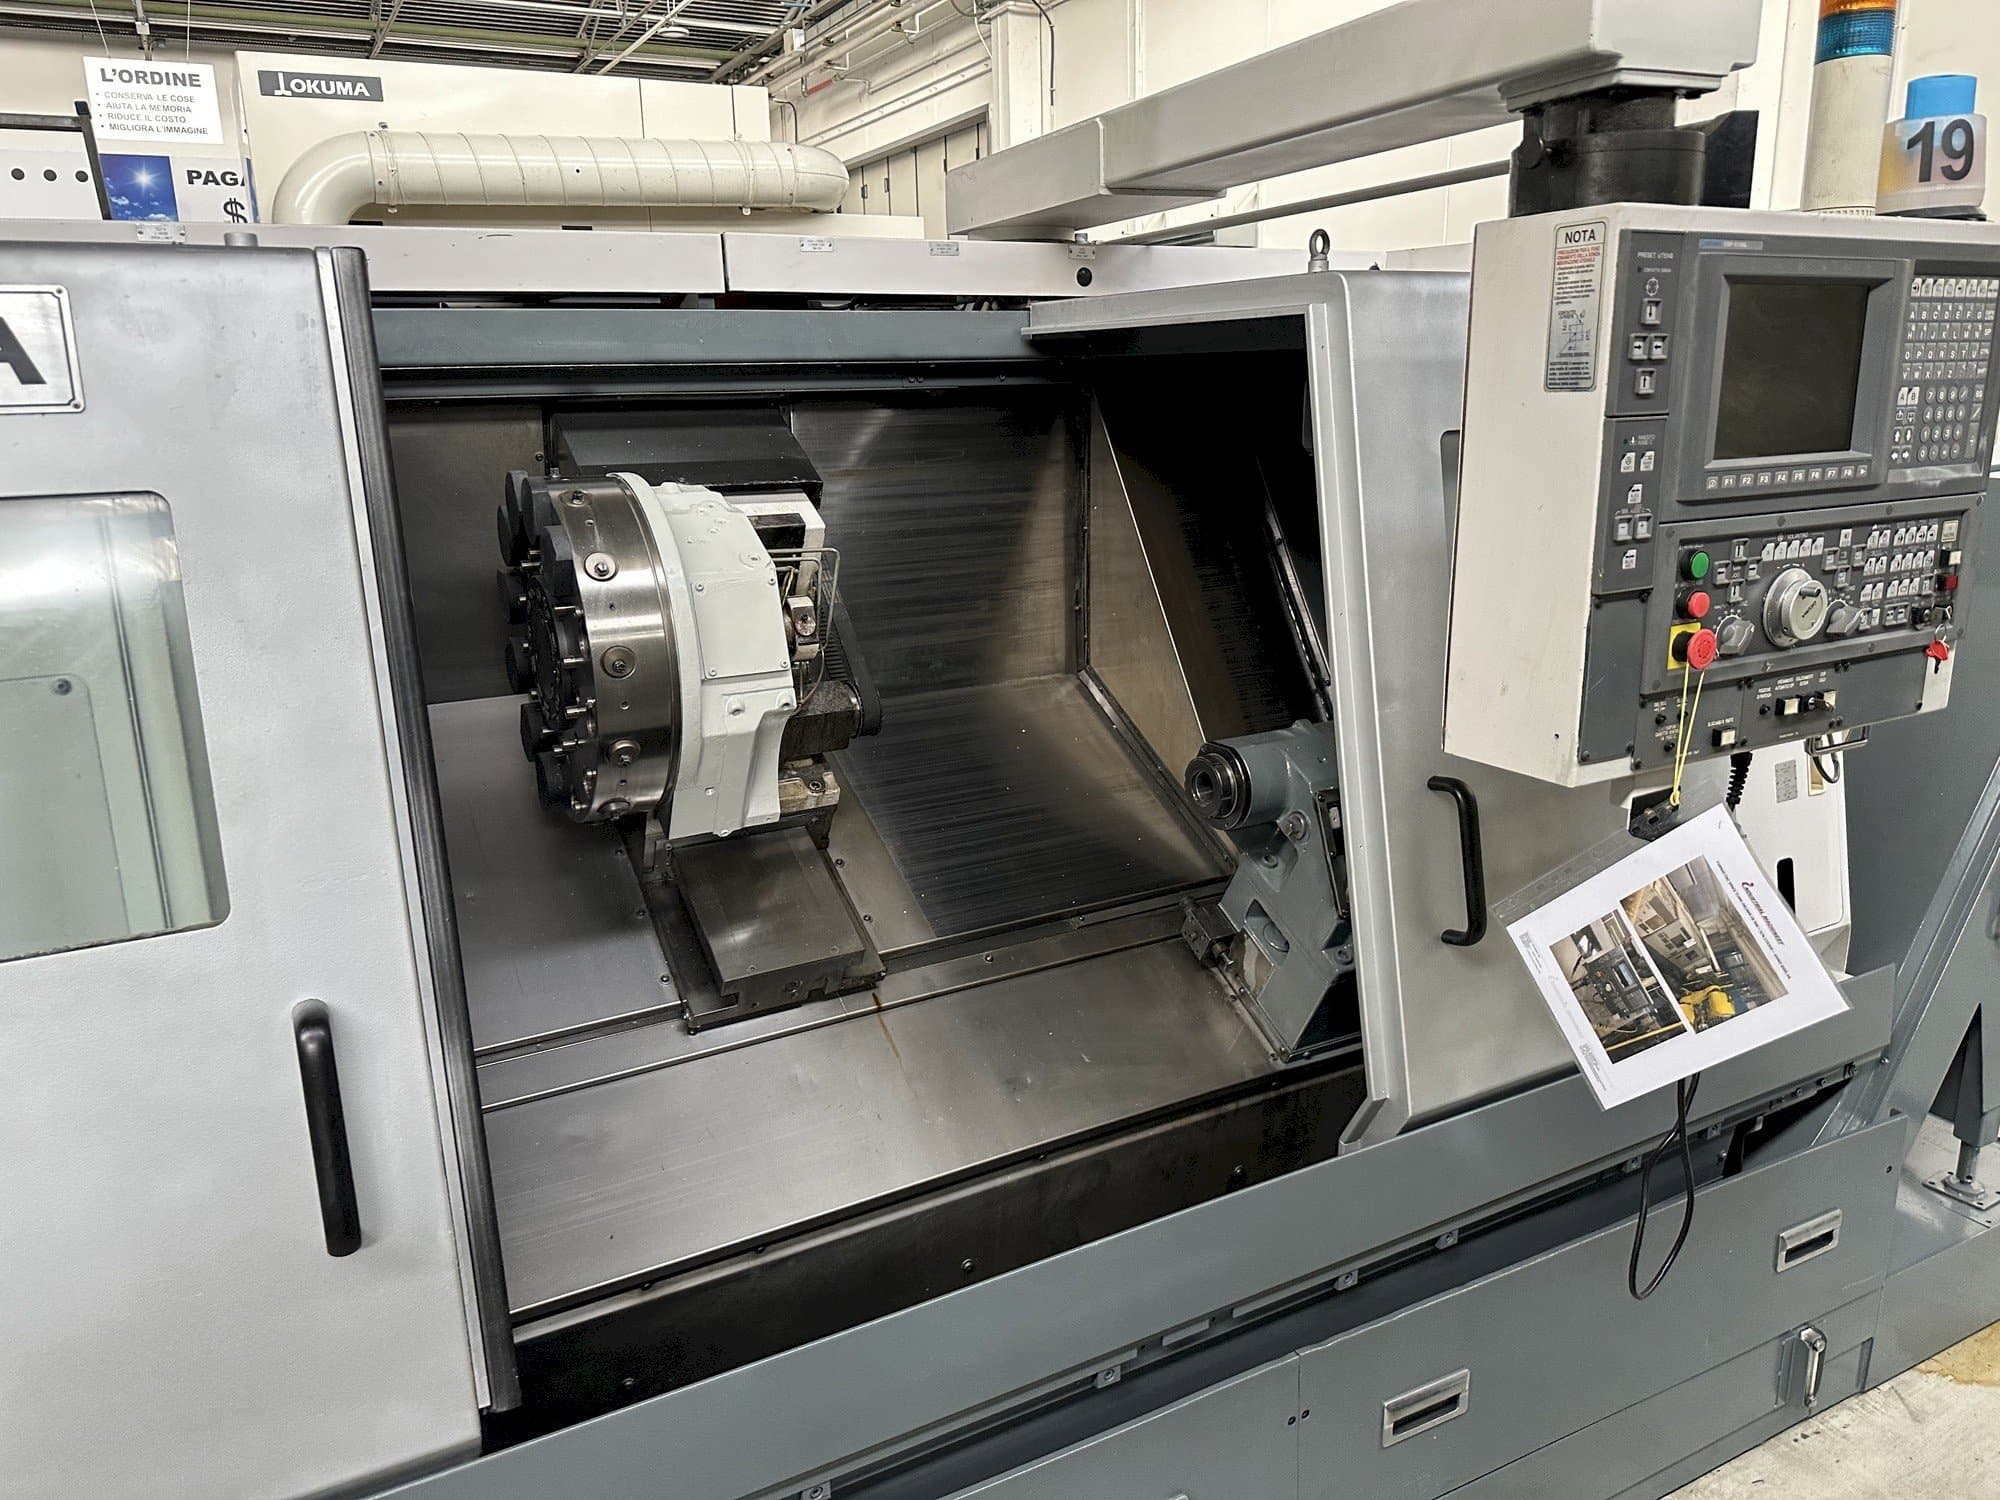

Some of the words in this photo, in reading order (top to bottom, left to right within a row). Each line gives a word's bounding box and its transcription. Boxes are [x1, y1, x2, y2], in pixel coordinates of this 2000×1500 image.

[100, 67, 202, 88] L'ORDINE
[290, 78, 370, 97] OKUMA
[104, 91, 154, 101] CONSERVA
[156, 94, 168, 102] LE
[170, 94, 195, 103] COSE
[106, 102, 133, 110] AIUTA
[135, 103, 147, 111] LA
[149, 104, 192, 113] MEMORIA
[107, 112, 141, 121] RIDUCE
[145, 113, 153, 122] IL
[155, 115, 187, 124] COSTO
[109, 123, 154, 132] MIGLIORA
[156, 125, 209, 135] L'IMMAGINE
[1907, 118, 1975, 183] 19
[1565, 229, 1596, 244] NOTA
